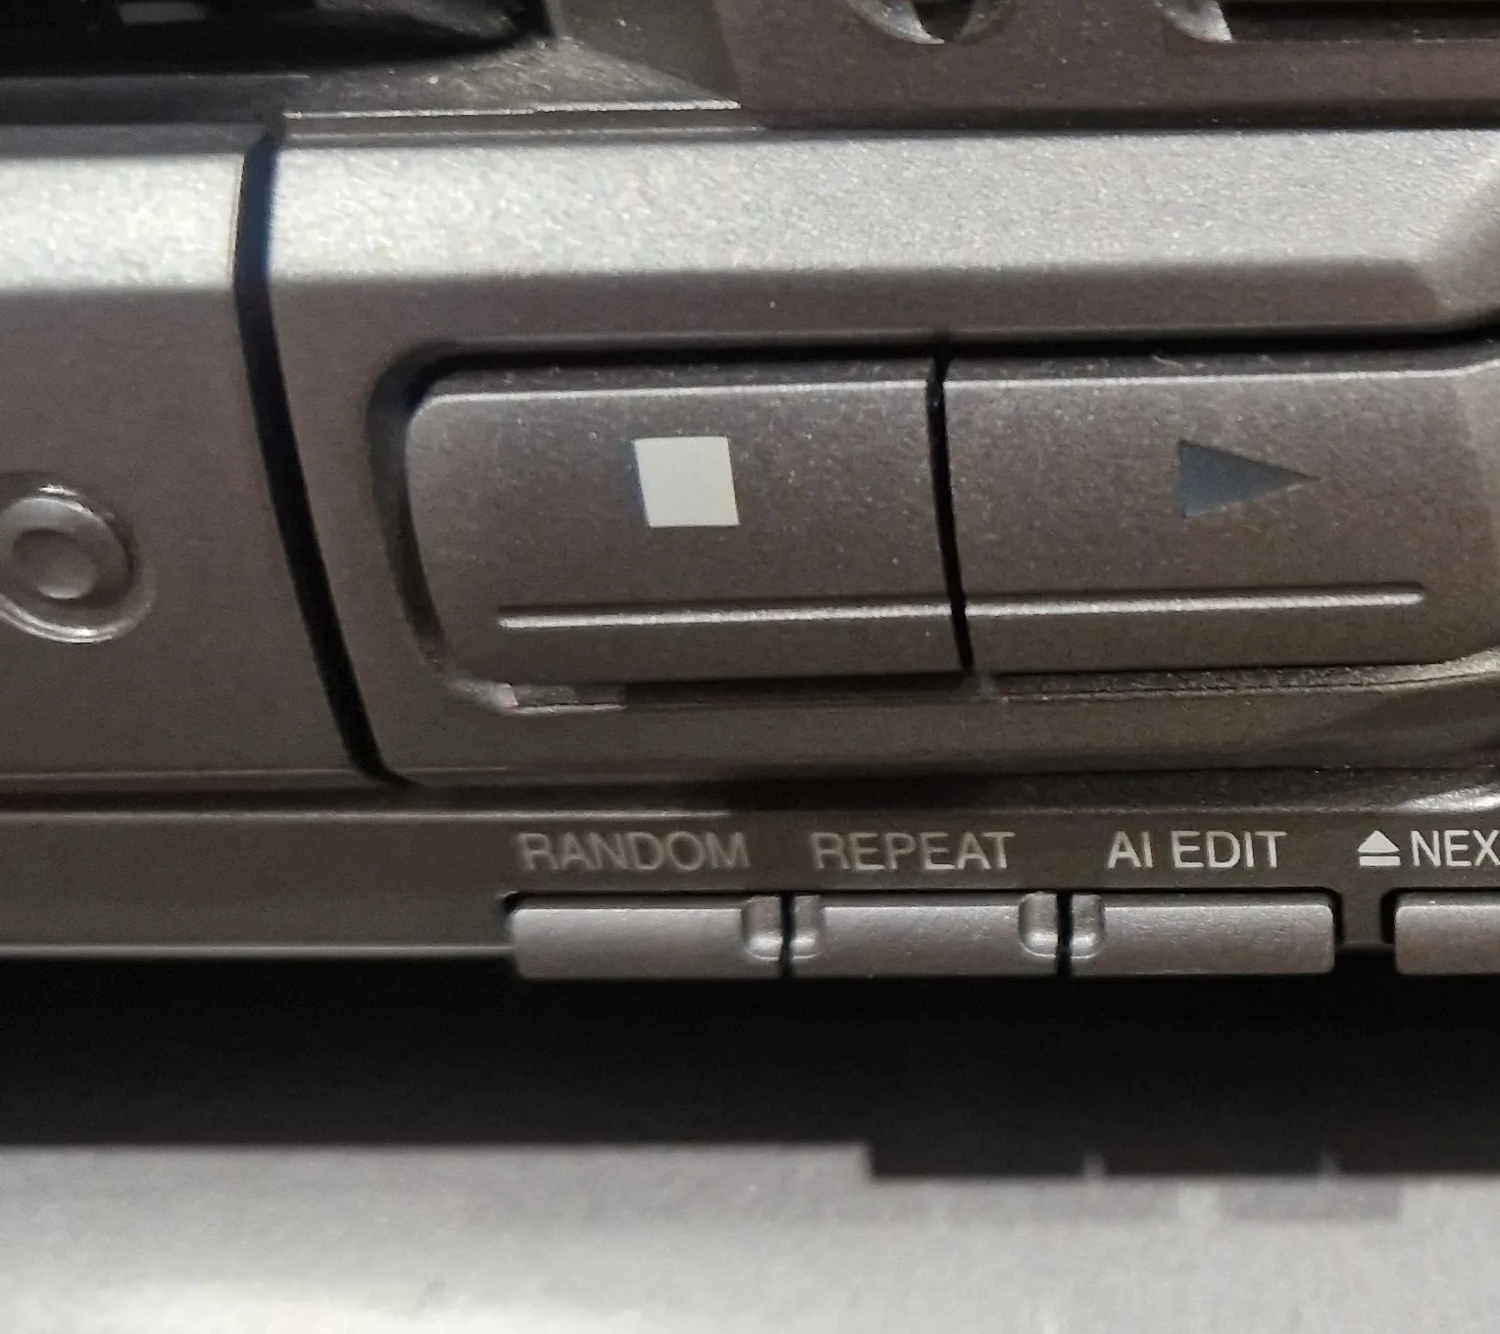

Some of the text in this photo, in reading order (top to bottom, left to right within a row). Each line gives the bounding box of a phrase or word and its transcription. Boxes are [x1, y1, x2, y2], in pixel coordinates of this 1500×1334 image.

[517, 831, 752, 871] RANDOM
[809, 831, 1016, 871] REPEAT
[1107, 830, 1288, 868] AI EDIT
